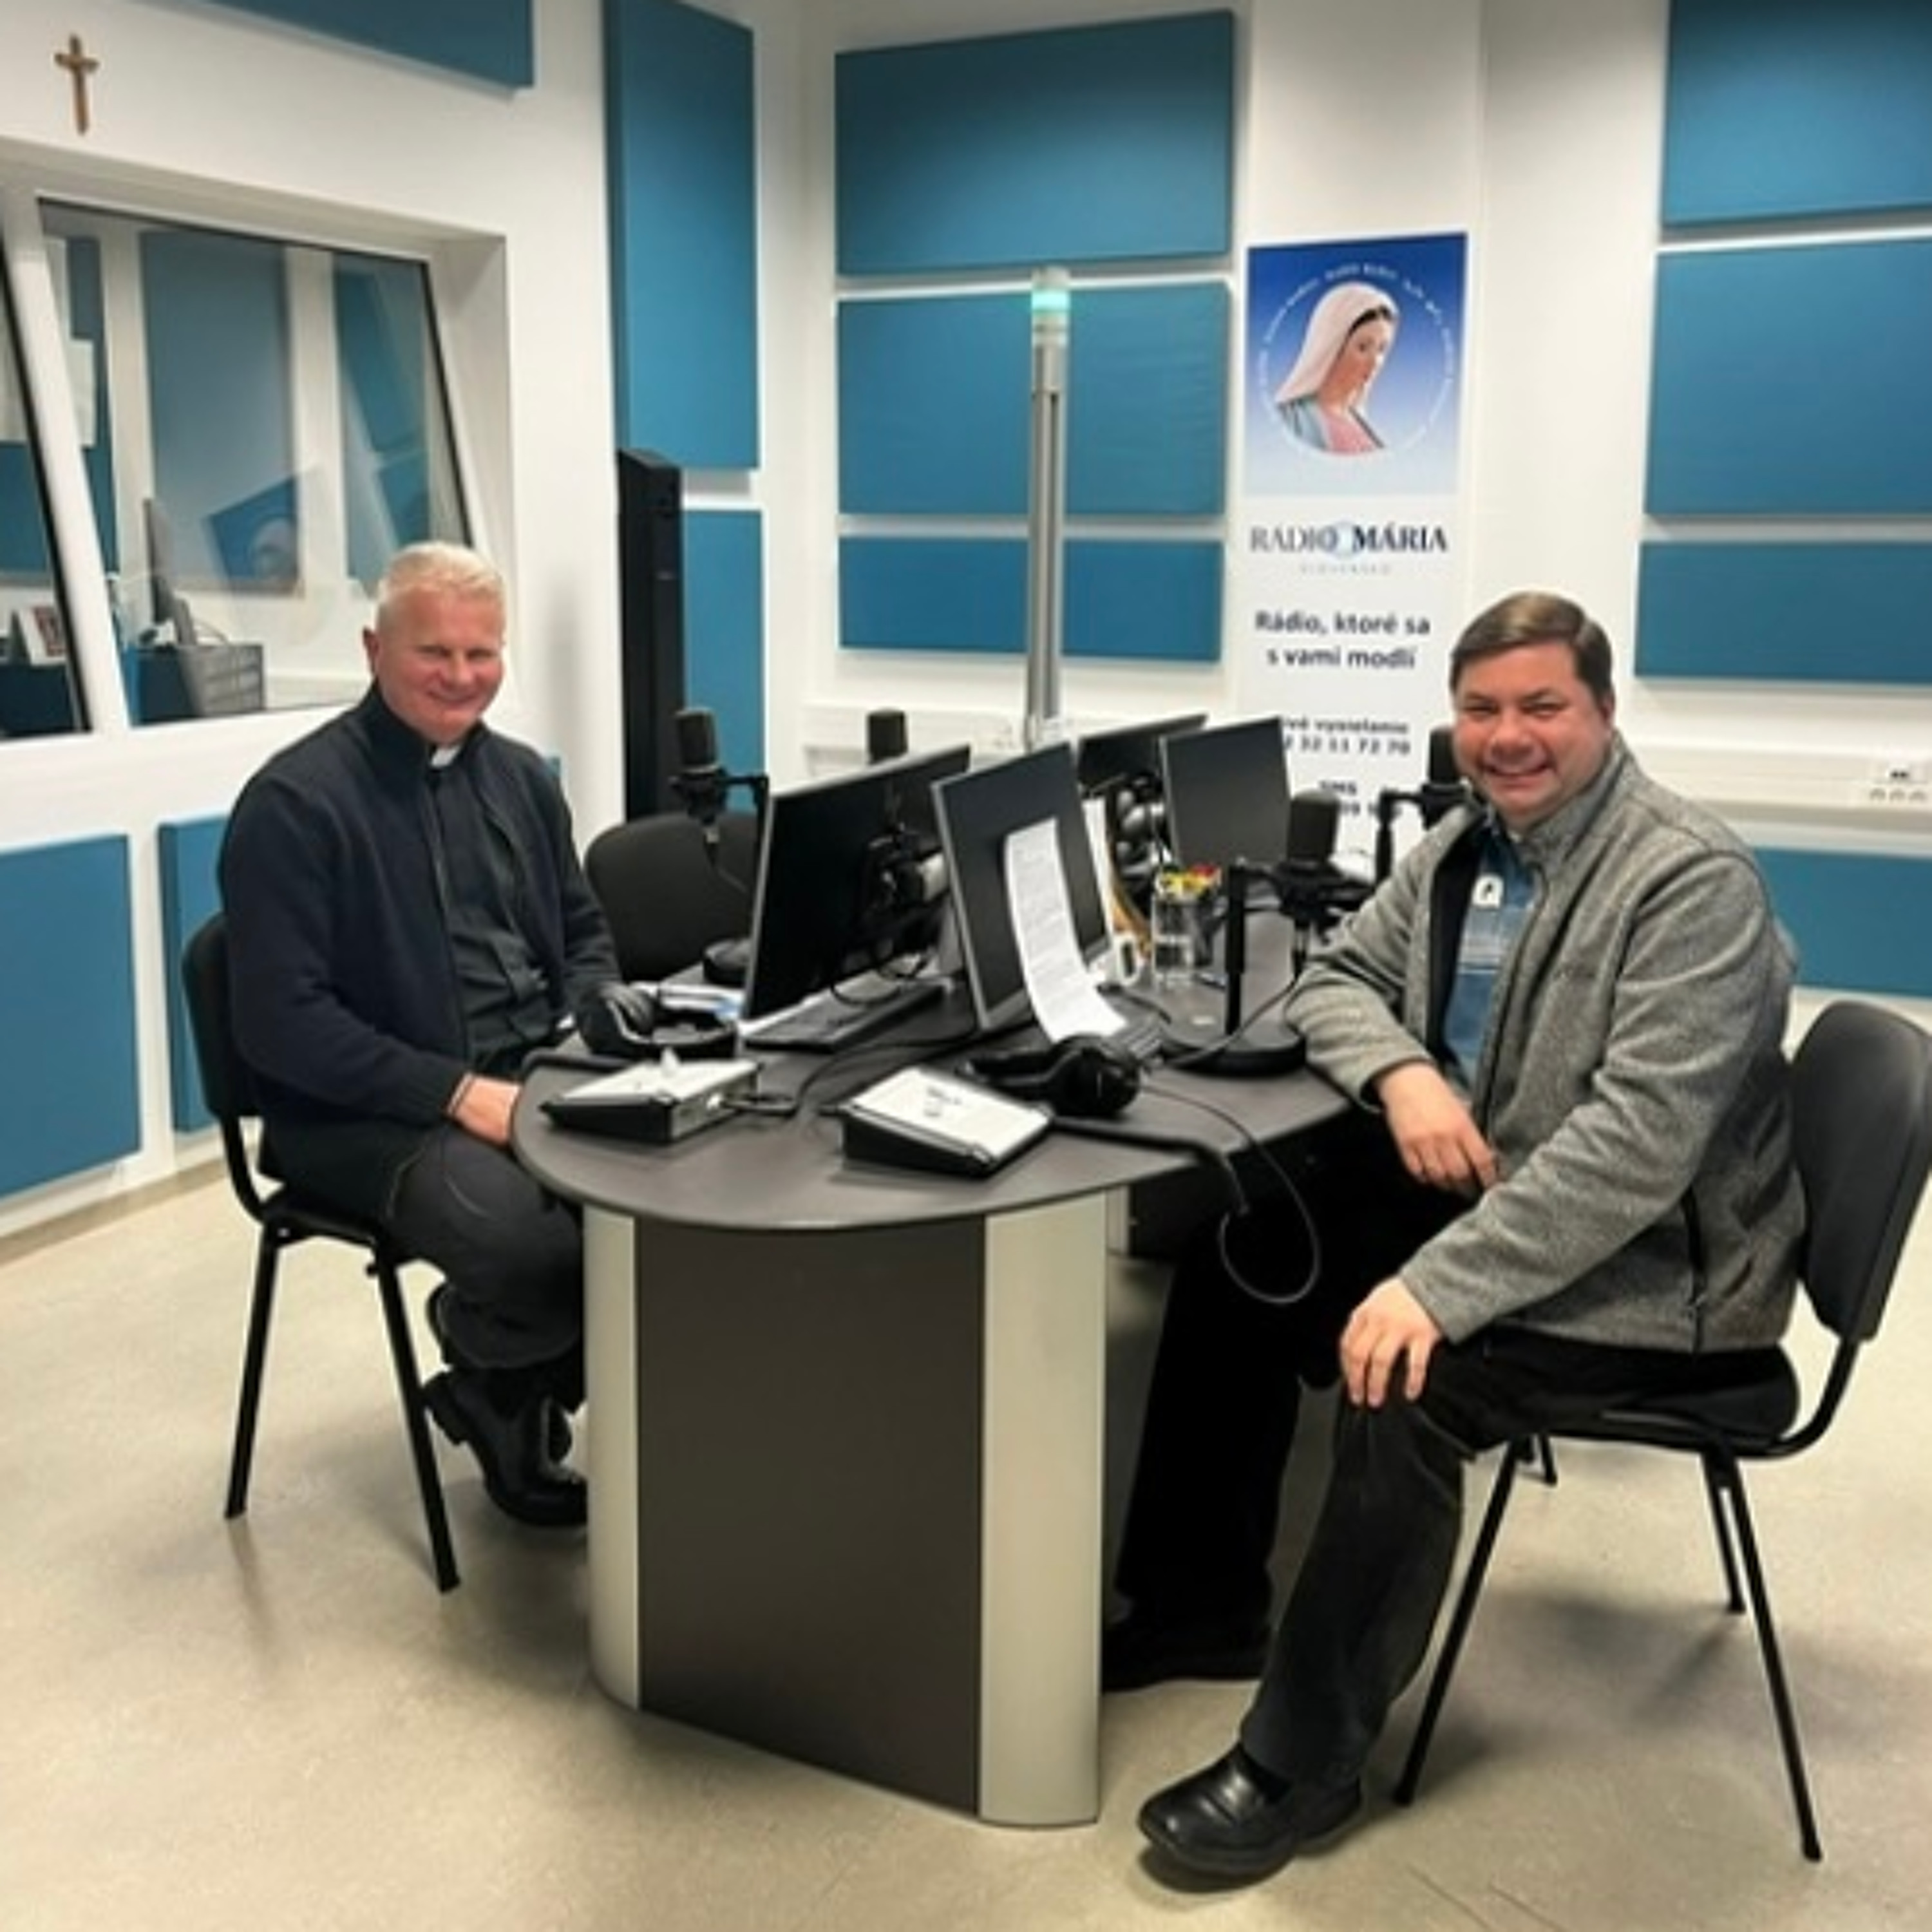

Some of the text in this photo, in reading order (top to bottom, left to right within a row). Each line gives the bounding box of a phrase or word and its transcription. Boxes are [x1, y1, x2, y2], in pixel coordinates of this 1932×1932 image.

[1352, 521, 1448, 551] MÁRIA
[1255, 609, 1430, 635] Rádio, ktoré sa
[1267, 649, 1278, 665] s
[1284, 646, 1341, 666] vami
